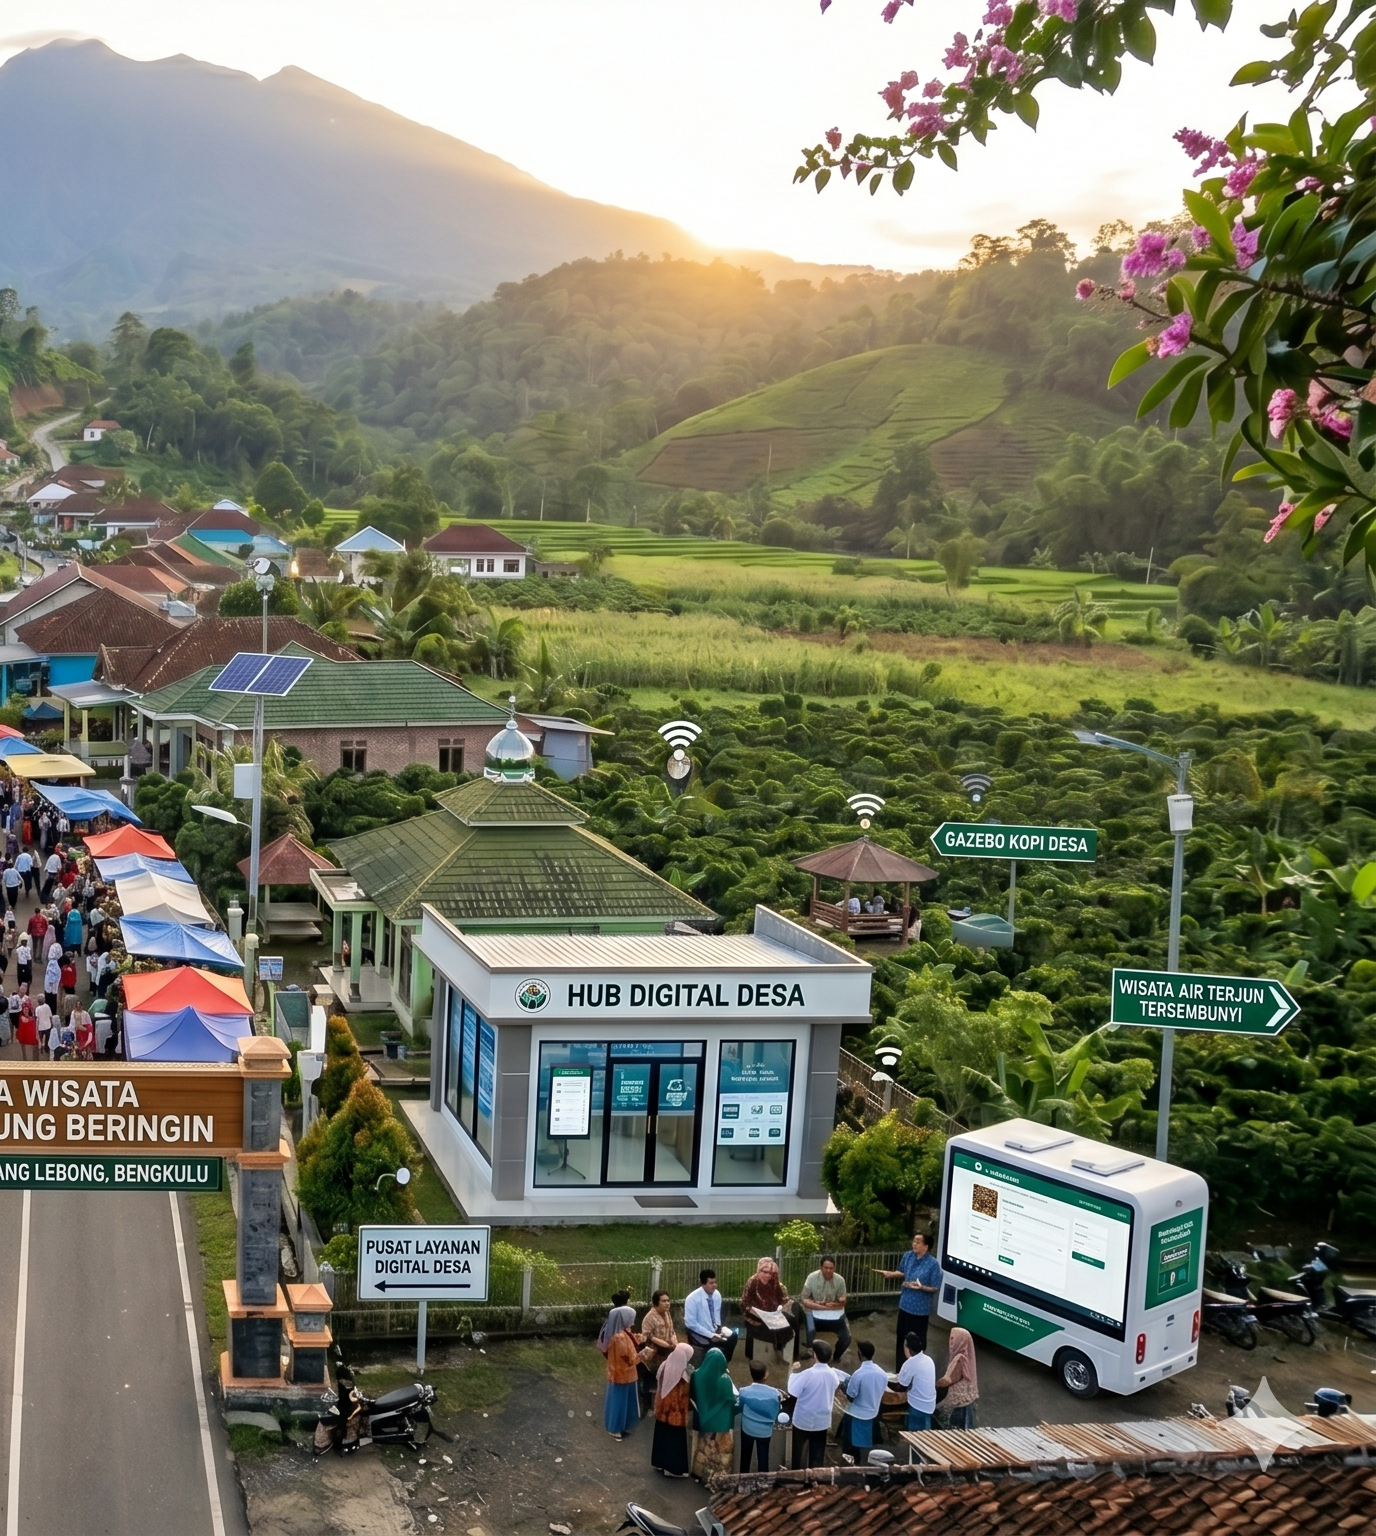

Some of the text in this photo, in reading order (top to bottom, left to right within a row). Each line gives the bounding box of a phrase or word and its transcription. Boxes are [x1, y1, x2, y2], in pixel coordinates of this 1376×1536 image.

[946, 832, 1087, 852] GAZEBO KOPI DESA
[569, 984, 620, 1007] HUB
[630, 984, 729, 1006] DIGITAL
[738, 984, 804, 1006] DESA
[1119, 979, 1263, 1003] WISATA AIR TERJUN
[1140, 1001, 1242, 1023] TERSEMBUNYI
[23, 1080, 139, 1107] WISATA
[67, 1114, 213, 1142] BERINGIN
[36, 1164, 109, 1183] LEBONG,
[115, 1165, 208, 1182] BENGKULU
[367, 1240, 480, 1254] PUSAT LAYANAN
[376, 1260, 471, 1273] DIGITAL DESA
